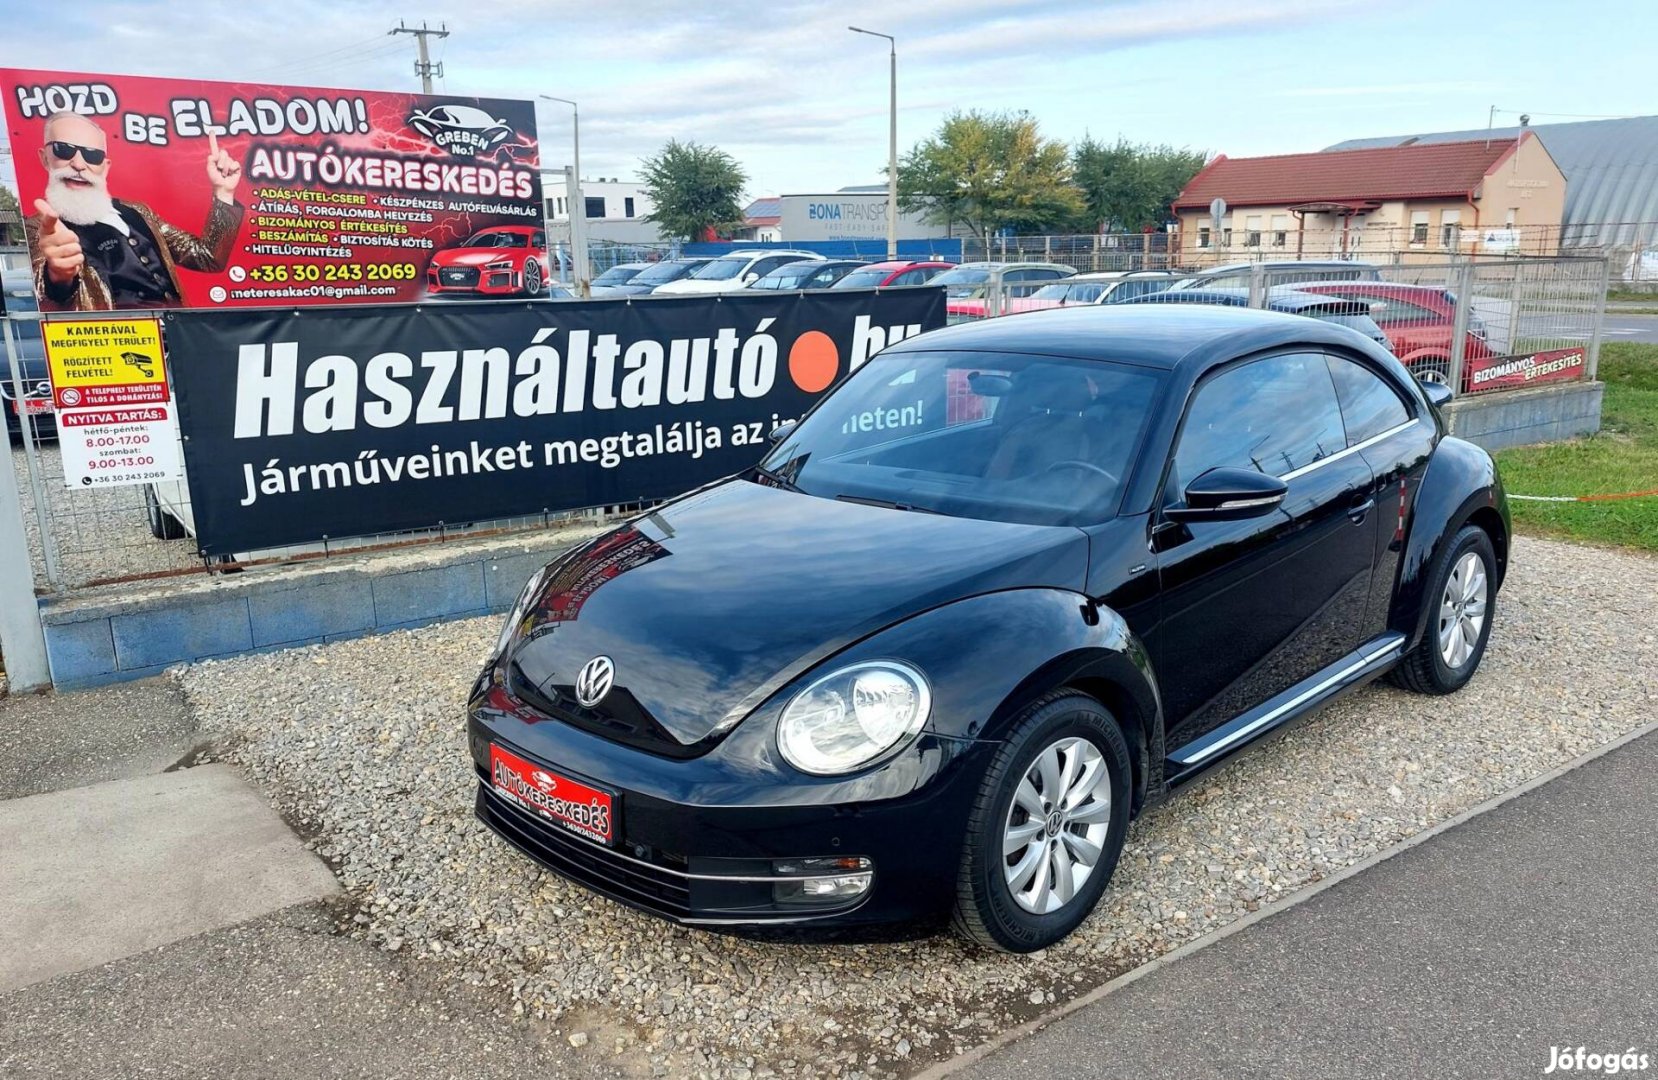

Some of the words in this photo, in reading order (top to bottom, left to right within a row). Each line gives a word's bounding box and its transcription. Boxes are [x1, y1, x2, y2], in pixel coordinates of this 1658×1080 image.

[17, 84, 118, 117] HOZD
[171, 98, 368, 136] ELADOM!
[124, 113, 168, 145] BE
[435, 130, 489, 151] GREBEN
[451, 144, 475, 156] No.1
[251, 146, 534, 199] AUTÓKERESKEDÉS
[260, 188, 367, 205] ADÁS-VÉTEL-CSERE
[380, 195, 445, 210] KÉSZPÉNZES
[448, 201, 537, 217] AUTÓFELVÁSÁRLÁS
[258, 201, 303, 216] ÁTÍRÁS,
[305, 206, 382, 219] FORGALOMBA
[384, 210, 433, 222] HELYEZÉS
[258, 216, 336, 230] BIZOMÁNYOS
[340, 219, 408, 234] ÉRTÉKESÍTÉS
[258, 230, 329, 244] BESZÁMÍTÁS
[340, 234, 400, 247] BIZTOSÍTÁS
[402, 237, 434, 249] KÖTÉS
[252, 243, 352, 258] HITELÜGYINTÉZÉS
[250, 265, 289, 282] +36
[292, 264, 320, 281] 30
[324, 264, 363, 281] 243
[366, 263, 417, 280] 2069
[66, 324, 138, 336] KAMERÁVAL
[51, 338, 110, 348] MEGFIGYELT
[114, 336, 156, 346] TERÜLET!
[63, 356, 112, 367] RÖGZÍTETT
[1473, 356, 1536, 384] BIZOMÁNYOS
[66, 368, 113, 378] FELVÉTEL!
[91, 386, 126, 394] TELEPHELY
[127, 384, 162, 393] TERÜLETÉN
[86, 396, 108, 404] TILOS
[68, 412, 114, 425] NYITVA
[115, 408, 162, 421] TARTÁS:
[86, 435, 150, 448] 8.00-17.00
[99, 448, 142, 457] szombat:
[88, 456, 154, 470] 9.00-13.00
[240, 440, 534, 506] Járműveinket
[544, 420, 722, 469] megtalálja
[731, 422, 764, 446] az
[94, 475, 110, 483] +36
[125, 473, 142, 481] 243
[143, 471, 166, 479] 2069
[494, 757, 610, 836] AUTÓKERESKEDÉS
